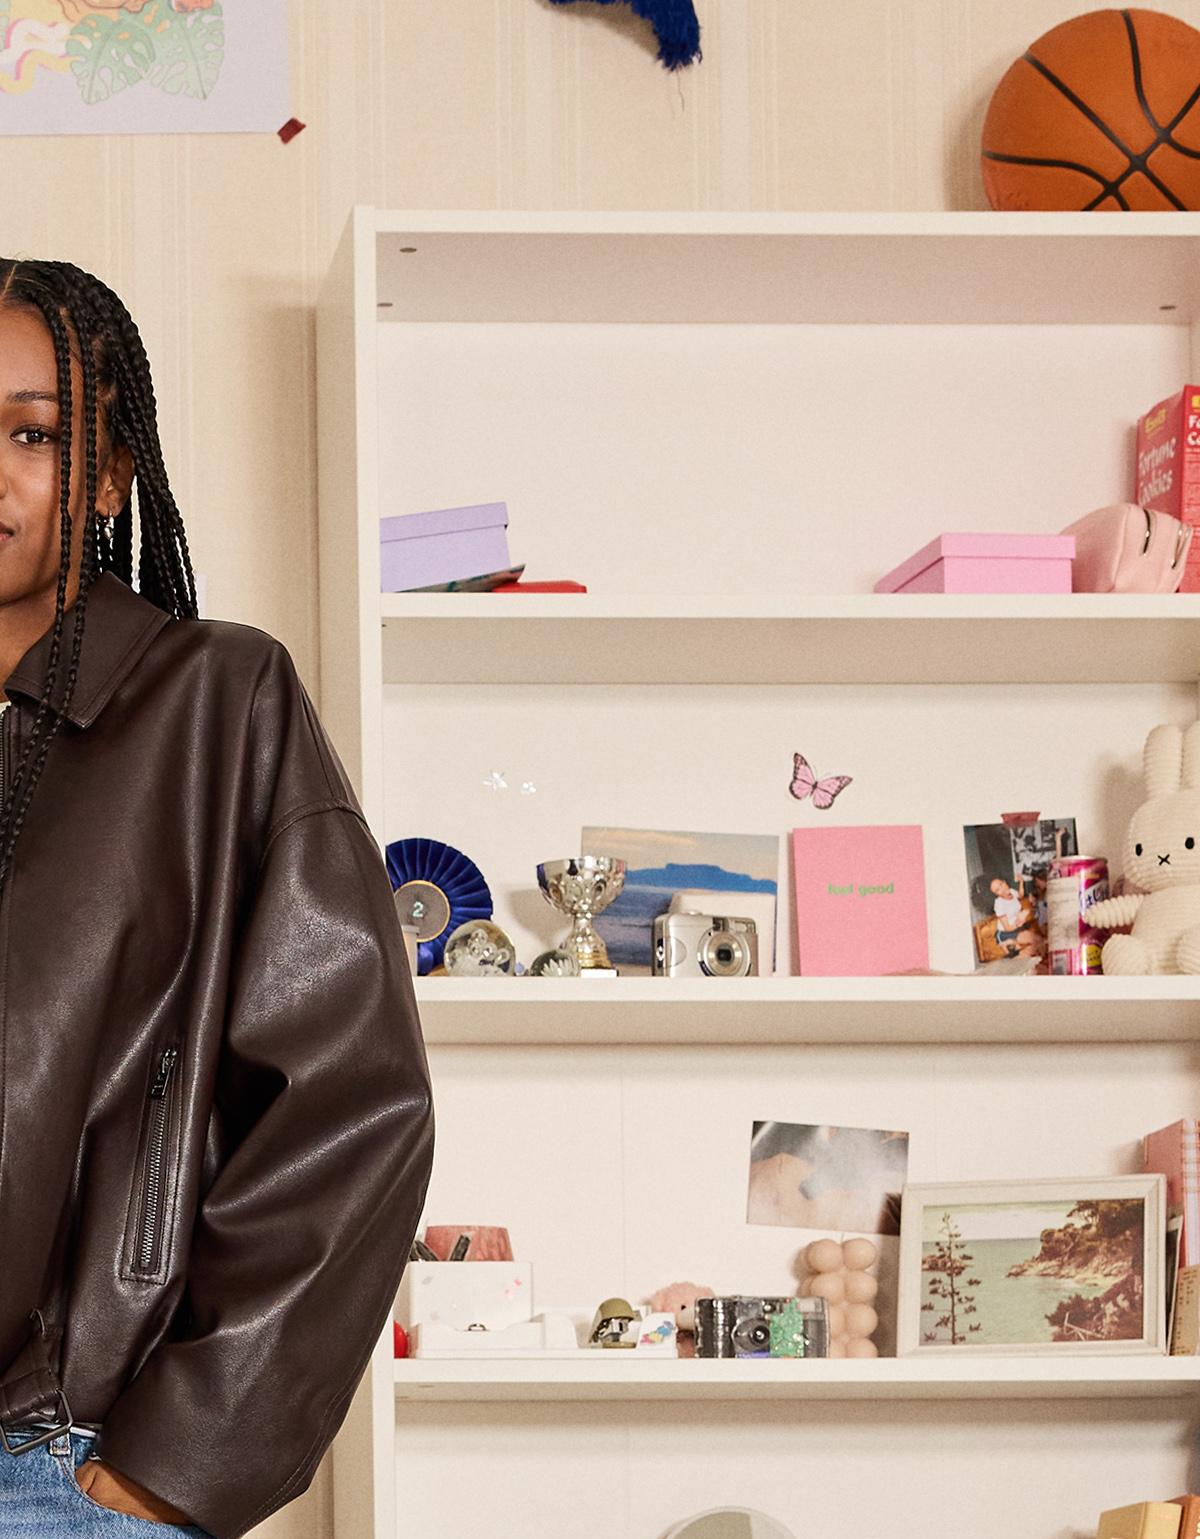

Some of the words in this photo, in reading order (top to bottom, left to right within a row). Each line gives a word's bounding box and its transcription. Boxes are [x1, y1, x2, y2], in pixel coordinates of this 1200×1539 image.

[827, 882, 854, 897] feel
[858, 881, 895, 900] good
[412, 901, 424, 918] 2
